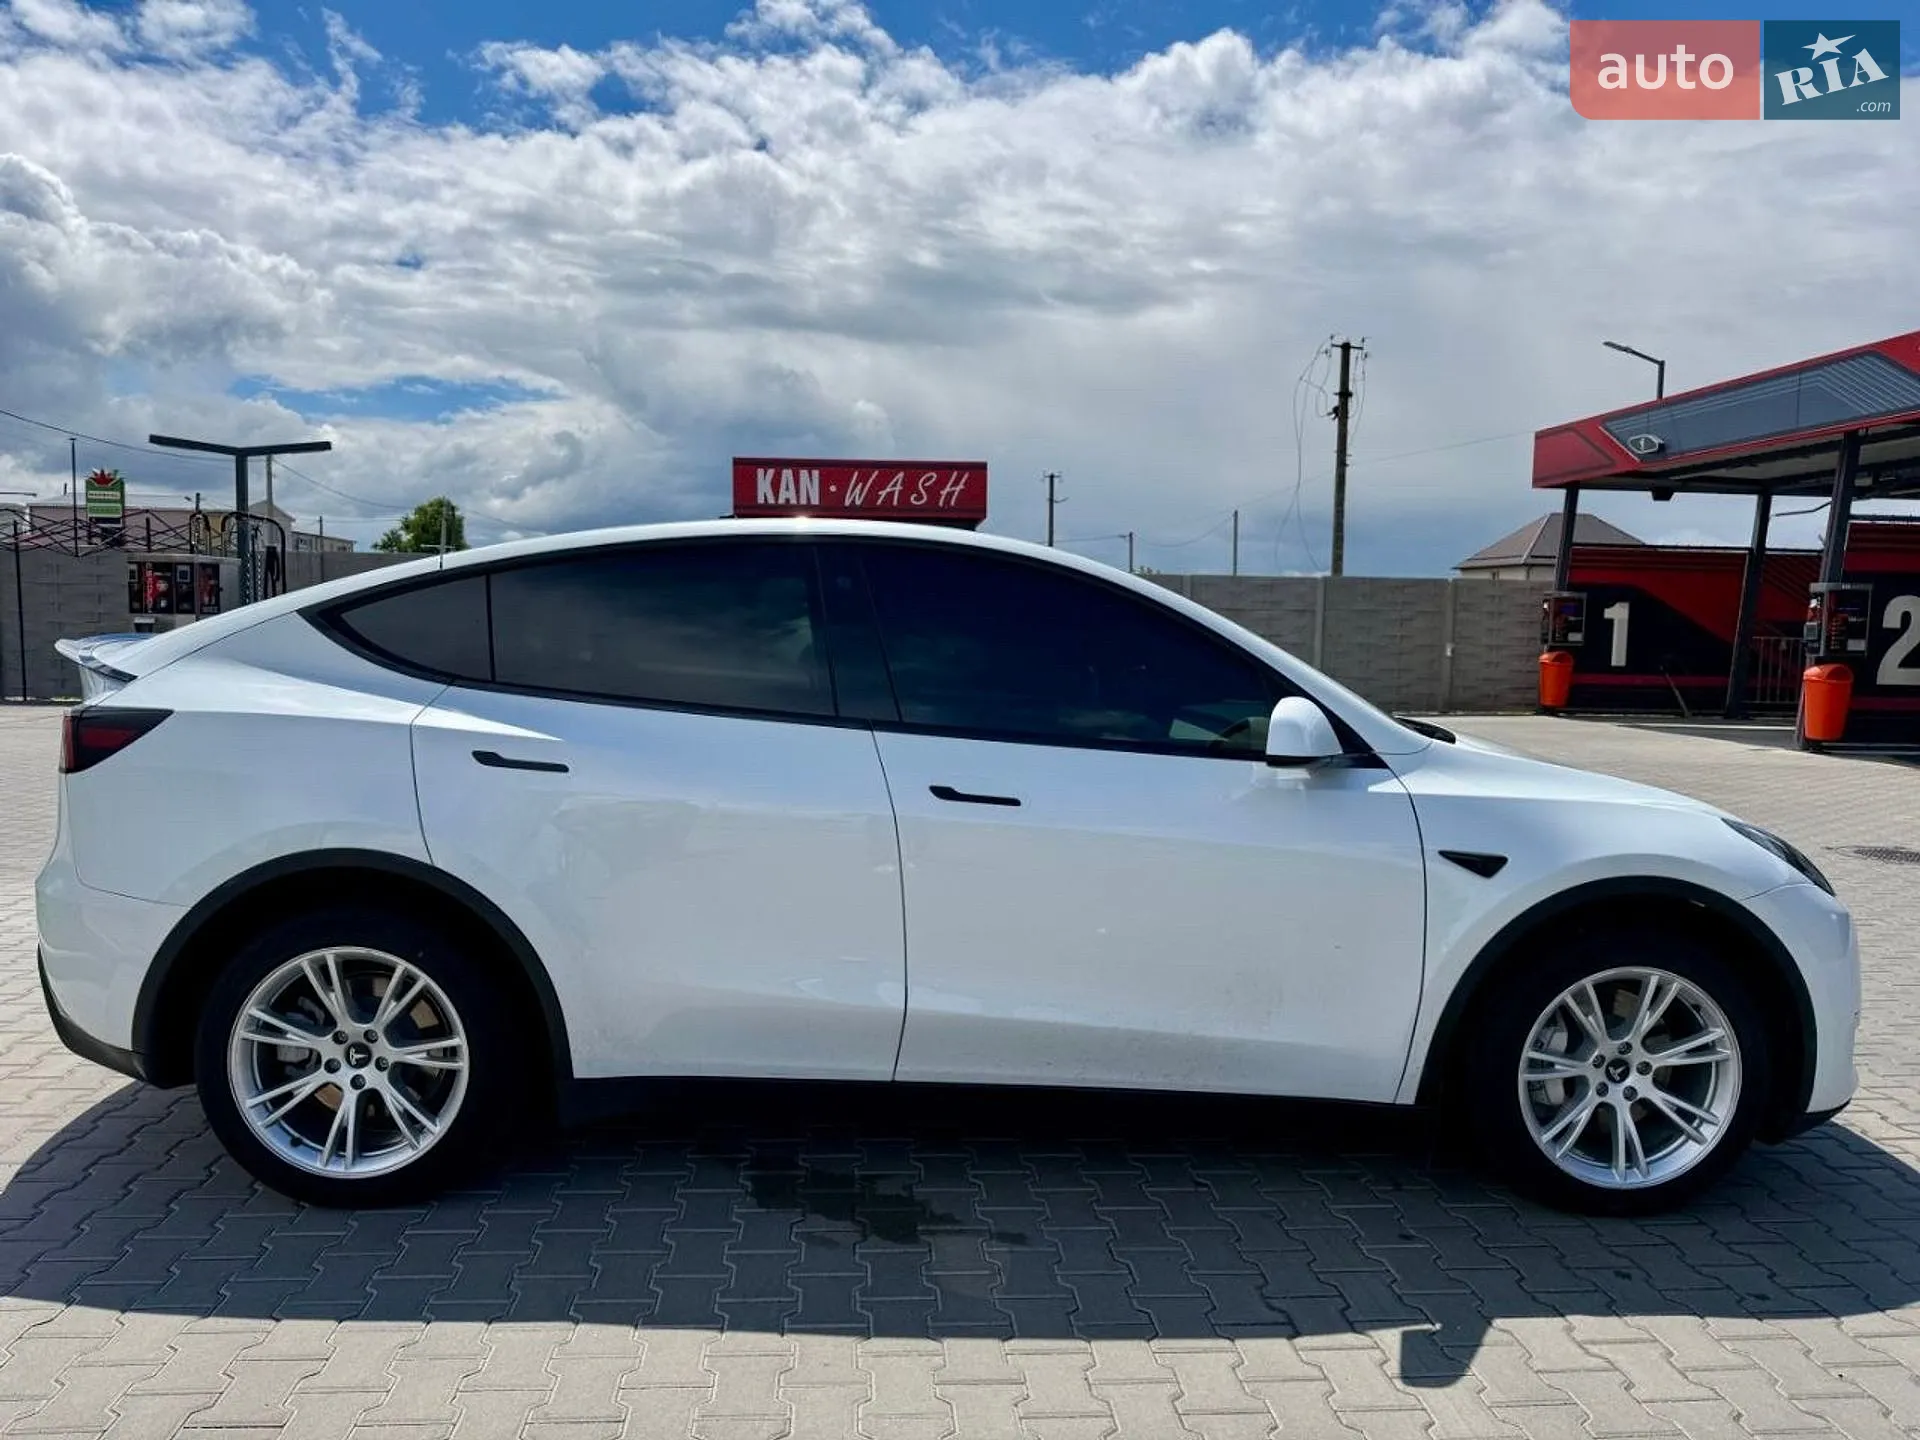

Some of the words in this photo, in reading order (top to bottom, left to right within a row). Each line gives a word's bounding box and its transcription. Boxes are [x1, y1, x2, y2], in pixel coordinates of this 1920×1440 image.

[756, 468, 820, 505] KAN
[844, 470, 970, 507] WASH
[1604, 602, 1629, 667] 1
[1876, 595, 1920, 685] 2
